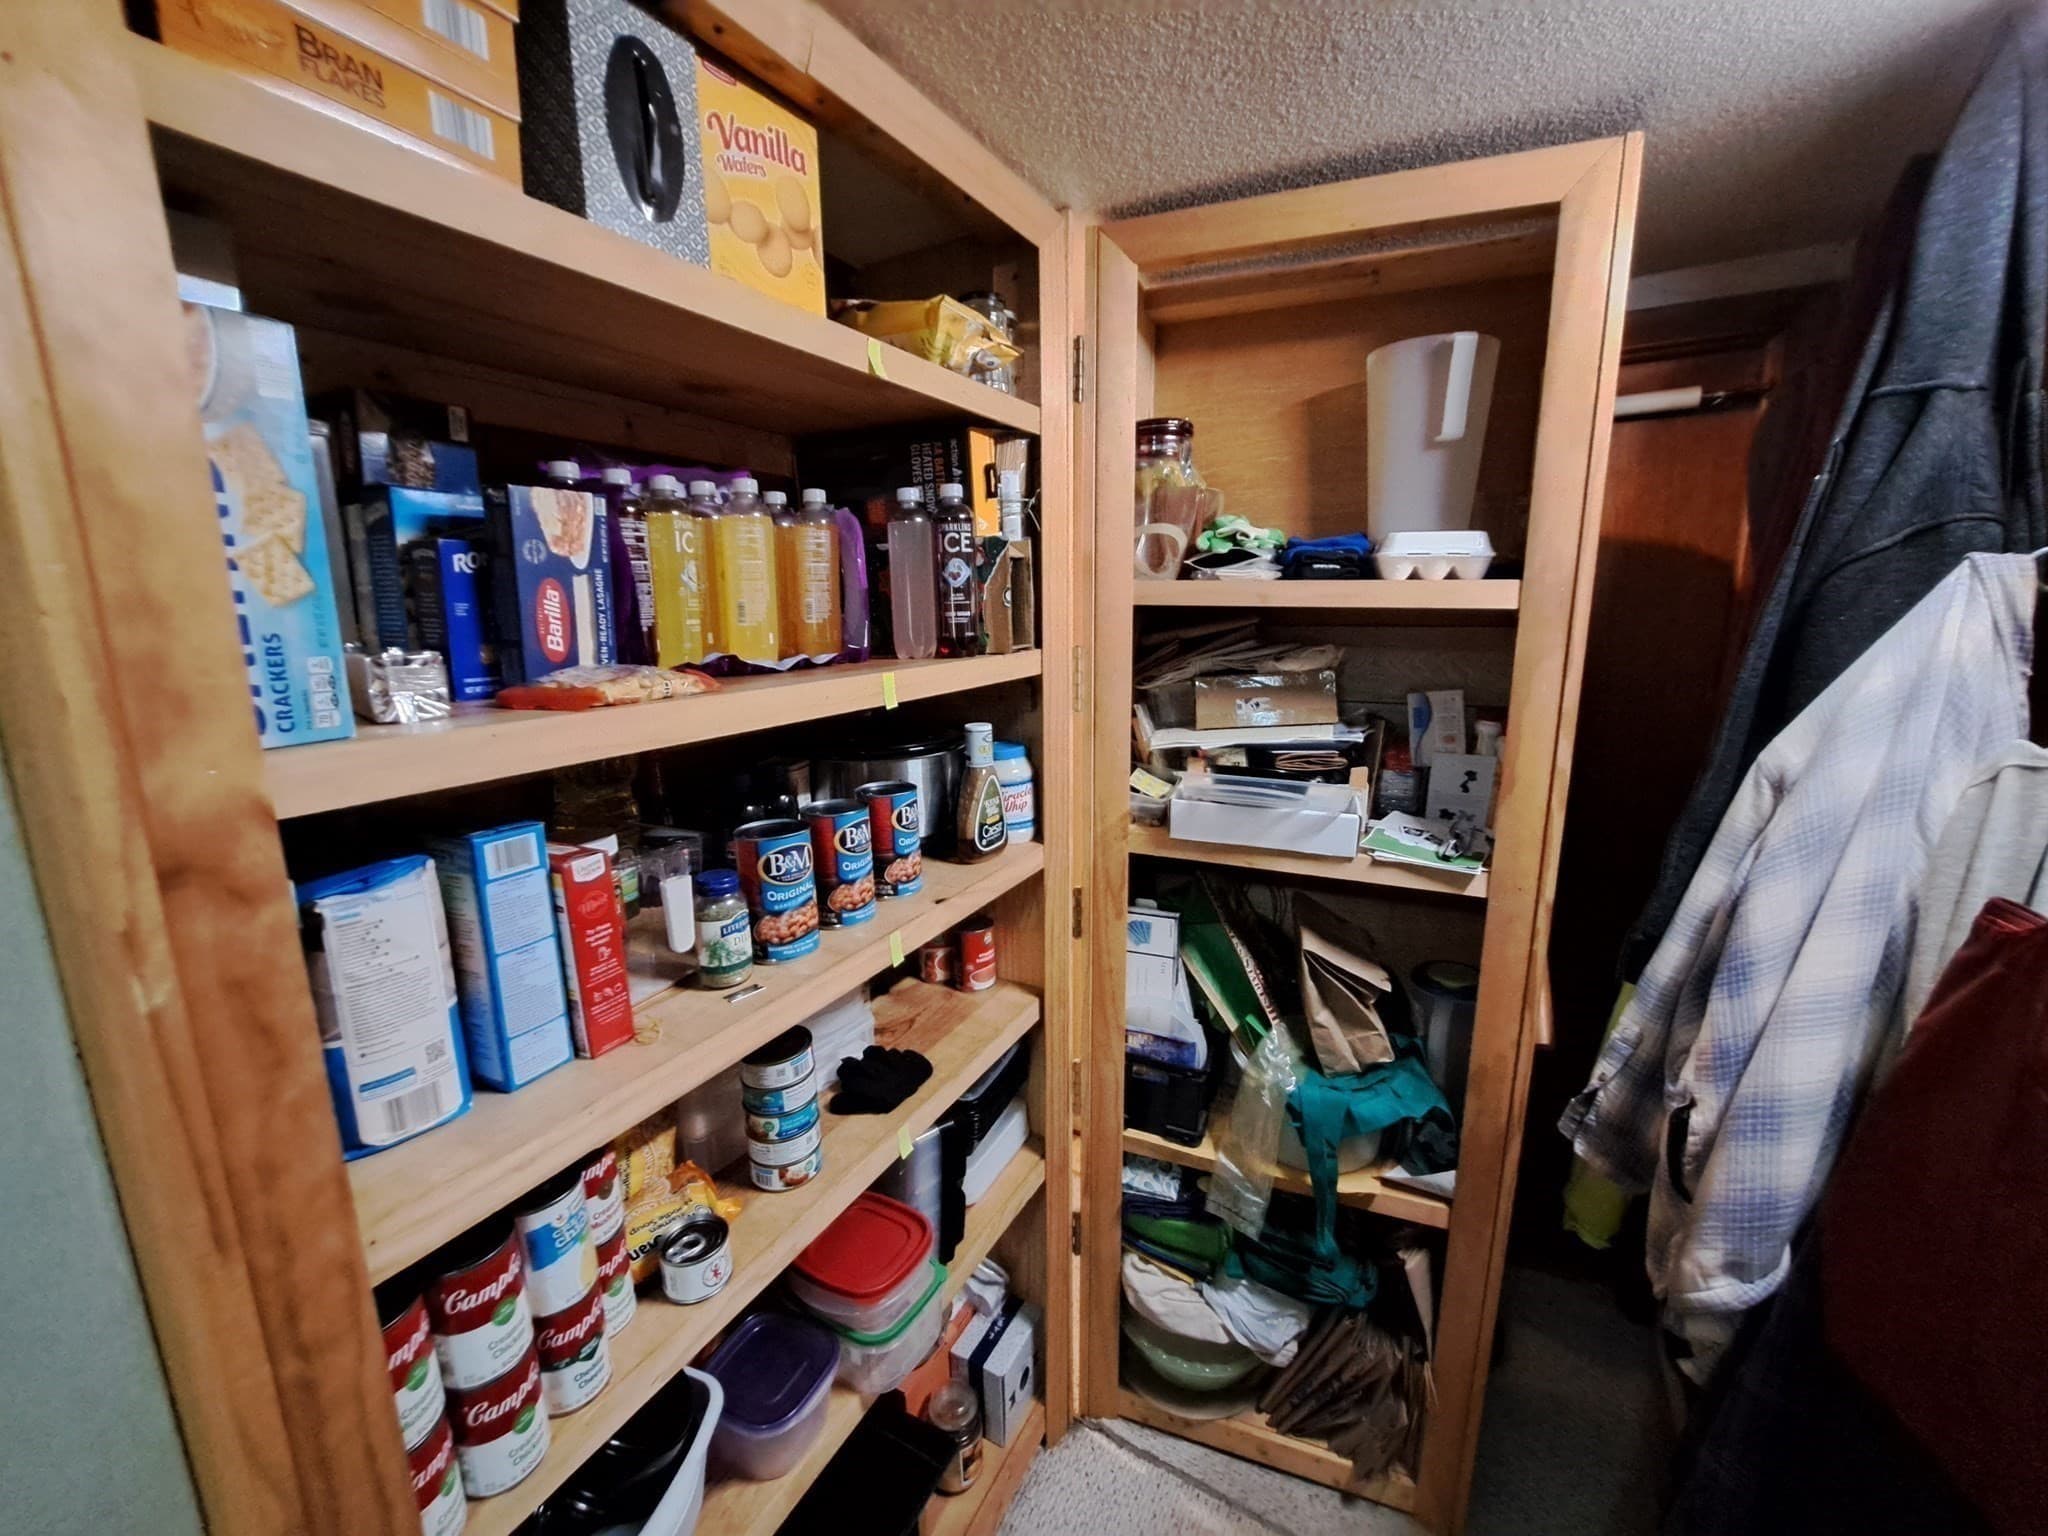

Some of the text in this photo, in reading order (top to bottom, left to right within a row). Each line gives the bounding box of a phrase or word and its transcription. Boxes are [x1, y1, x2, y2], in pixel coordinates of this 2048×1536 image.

[294, 23, 385, 91] BRAN
[299, 53, 387, 109] FLAKES
[706, 111, 807, 176] Vanilla
[911, 443, 922, 484] GLOVES
[921, 442, 934, 480] HEATED
[674, 530, 696, 553] IC
[593, 567, 606, 611] LASAGNE
[543, 588, 565, 652] Barilla
[262, 633, 296, 733] CRACKERS
[768, 845, 812, 877] B&M
[766, 879, 815, 902] ORIGINAL
